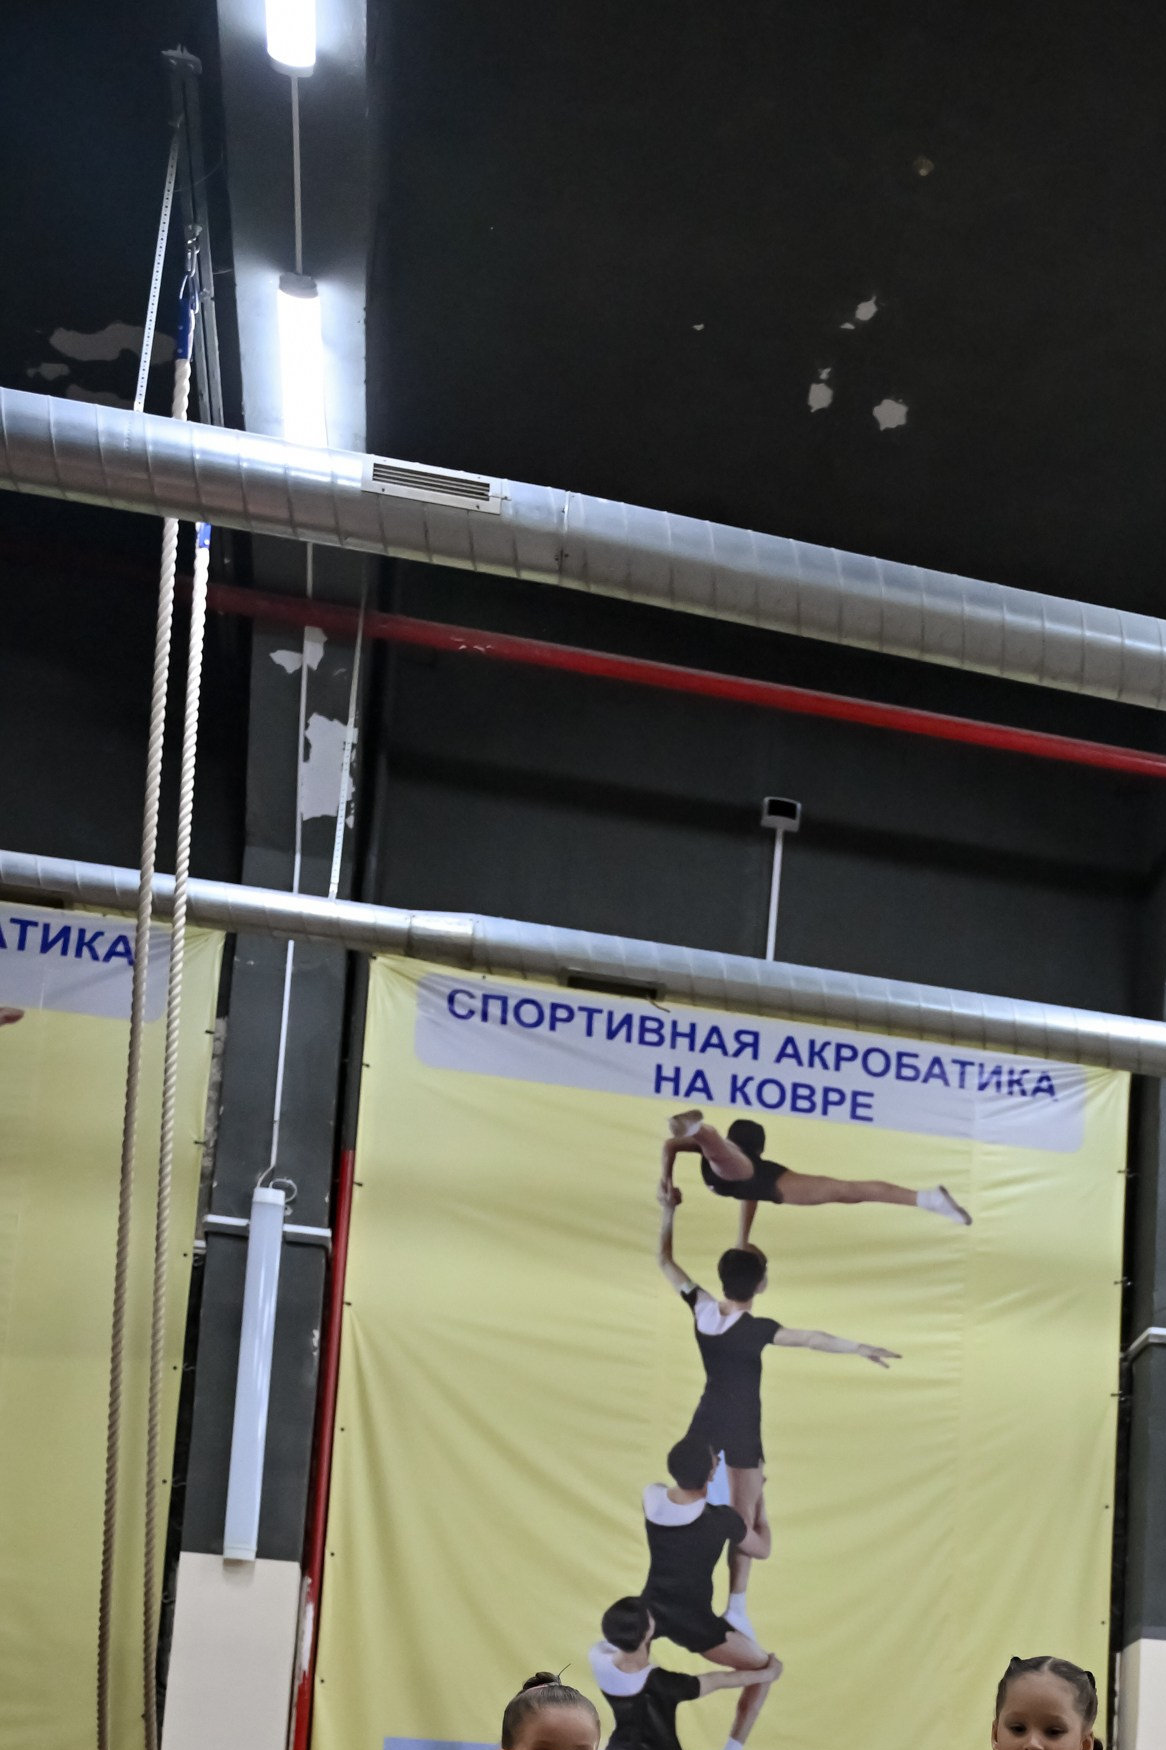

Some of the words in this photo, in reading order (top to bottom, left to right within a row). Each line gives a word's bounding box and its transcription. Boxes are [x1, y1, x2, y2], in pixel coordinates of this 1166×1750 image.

[447, 988, 760, 1060] СПОРТИВНАЯ
[774, 1035, 1059, 1102] АКРОБАТИКА
[654, 1063, 714, 1101] НА
[729, 1074, 874, 1122] КОВРЕ
